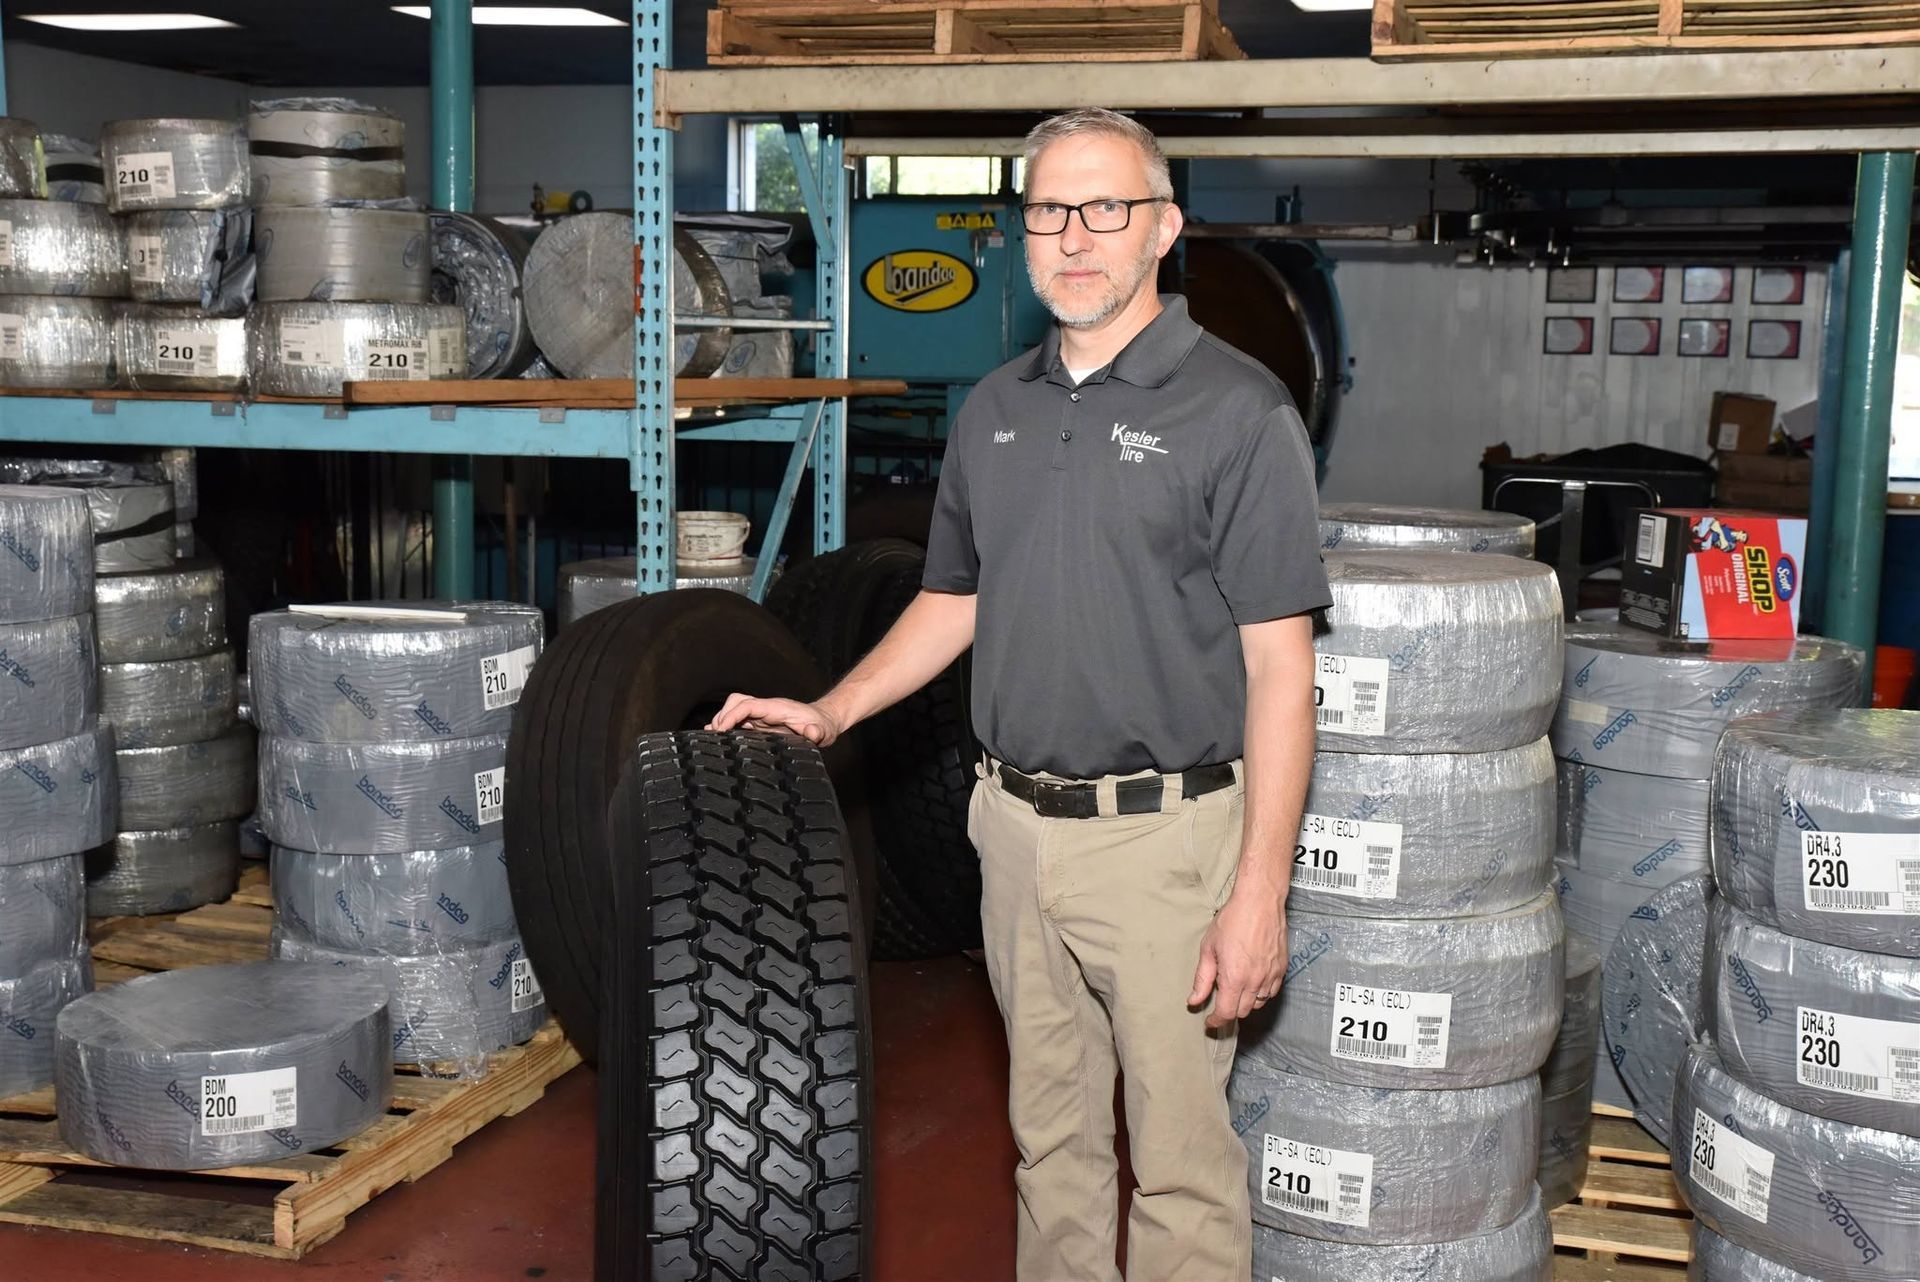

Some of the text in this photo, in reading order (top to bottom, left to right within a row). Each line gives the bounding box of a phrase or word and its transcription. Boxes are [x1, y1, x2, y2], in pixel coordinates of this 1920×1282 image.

[119, 168, 149, 184] 210
[884, 255, 957, 305] bandag
[159, 345, 193, 360] 210
[369, 353, 408, 368] 210
[993, 430, 1016, 444] Mark
[1110, 422, 1162, 448] Kesler
[1119, 443, 1145, 464] Tire
[1731, 553, 1750, 605] ORIGINAL
[1744, 546, 1776, 614] SHOP
[1777, 566, 1793, 594] Scott
[484, 658, 499, 674] BDM
[1318, 655, 1347, 674] (ECL)
[486, 672, 507, 693] 210
[333, 673, 378, 720] bandag
[1593, 709, 1638, 750] bandag
[477, 772, 493, 789] BDM
[479, 786, 501, 809] 210
[438, 795, 481, 834] bandag
[1302, 817, 1361, 839] L-SA (ECL)
[1293, 844, 1338, 870] 210
[1807, 834, 1842, 857] DR4.3
[1808, 858, 1849, 888] 230
[436, 892, 470, 925] ndag
[489, 942, 520, 990] bandag
[514, 975, 532, 997] 210
[1339, 985, 1412, 1010] BTL-SA (ECL)
[1339, 1016, 1388, 1042] 210
[1802, 1011, 1836, 1037] DR4.3
[1802, 1034, 1841, 1068] 230
[205, 1078, 226, 1096] BDM
[205, 1096, 237, 1118] 200
[1267, 1135, 1332, 1166] BTL-SA (ECL)
[1693, 1134, 1716, 1171] 230
[1267, 1166, 1311, 1195] 210
[1817, 1190, 1884, 1265] bandag
